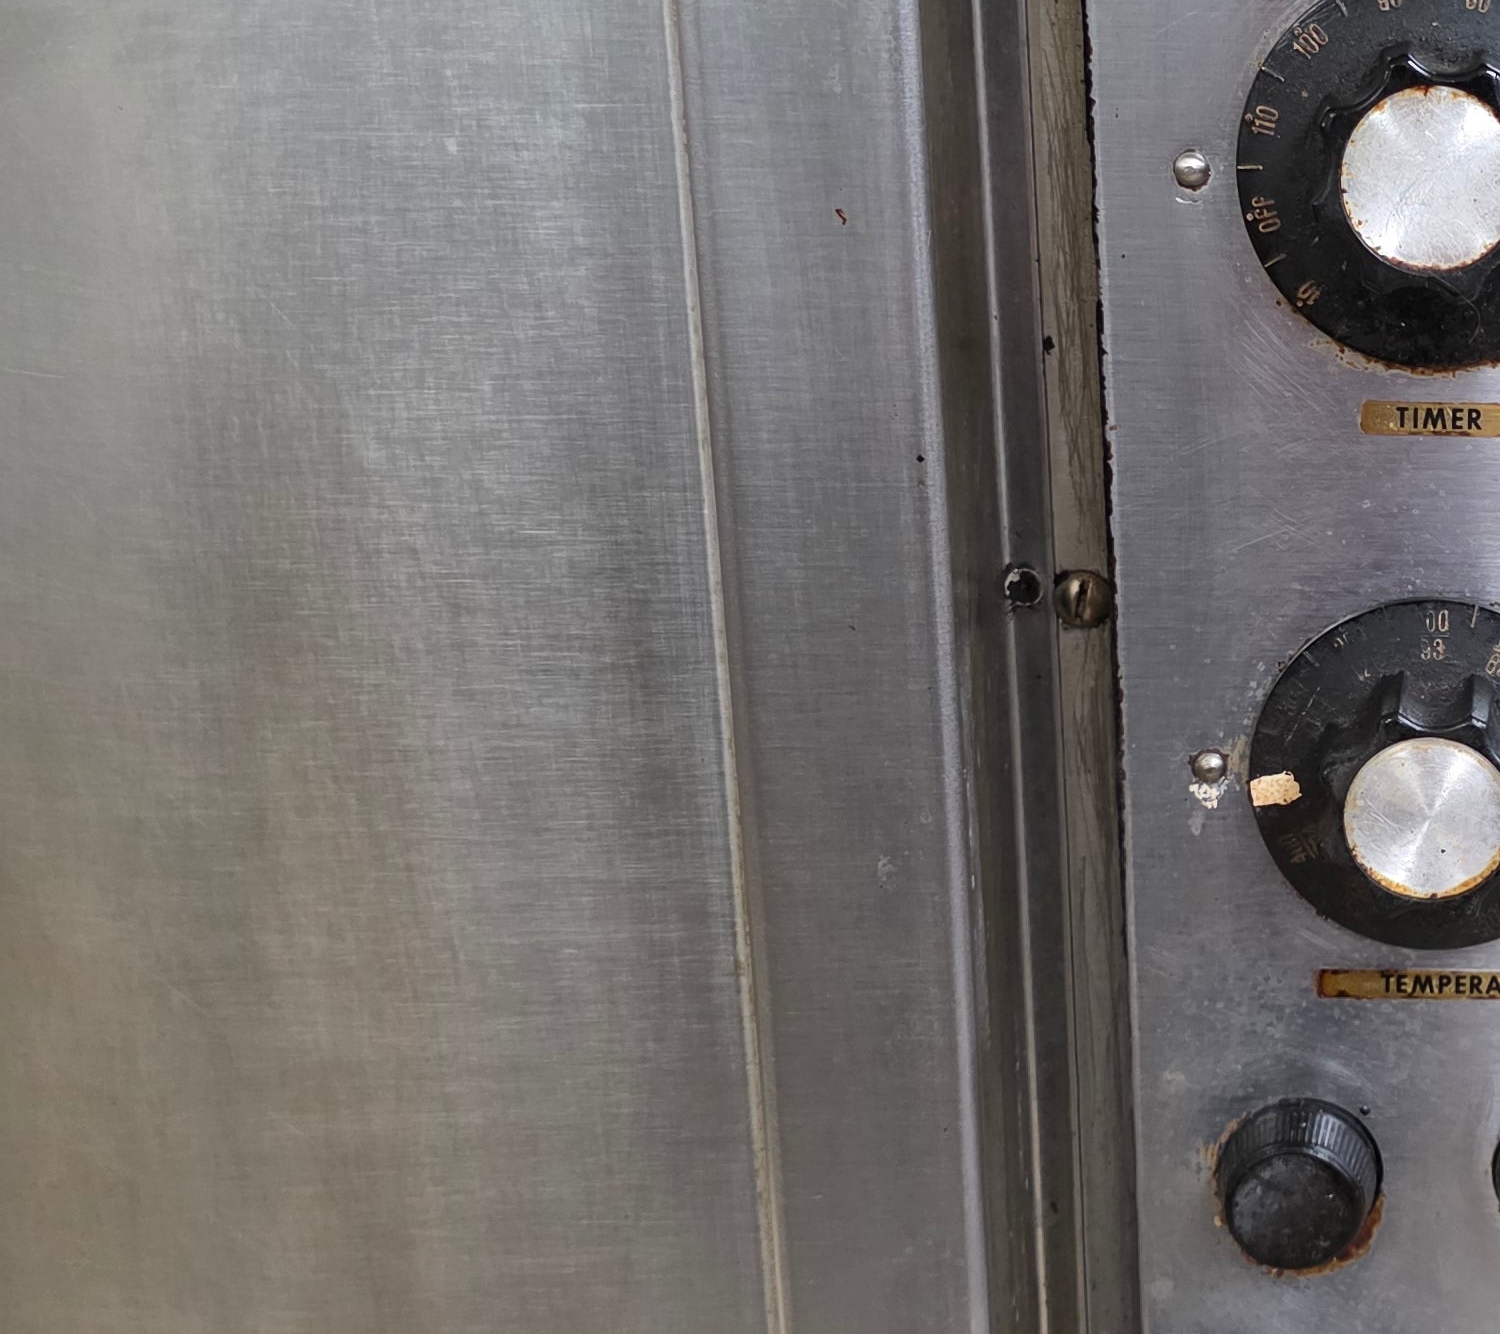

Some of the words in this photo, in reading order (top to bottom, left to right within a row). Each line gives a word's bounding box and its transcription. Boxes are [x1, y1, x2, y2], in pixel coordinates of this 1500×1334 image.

[1293, 22, 1329, 60] 100
[1251, 105, 1279, 136] 110
[1251, 195, 1282, 233] OFF
[1396, 407, 1482, 431] TIMER
